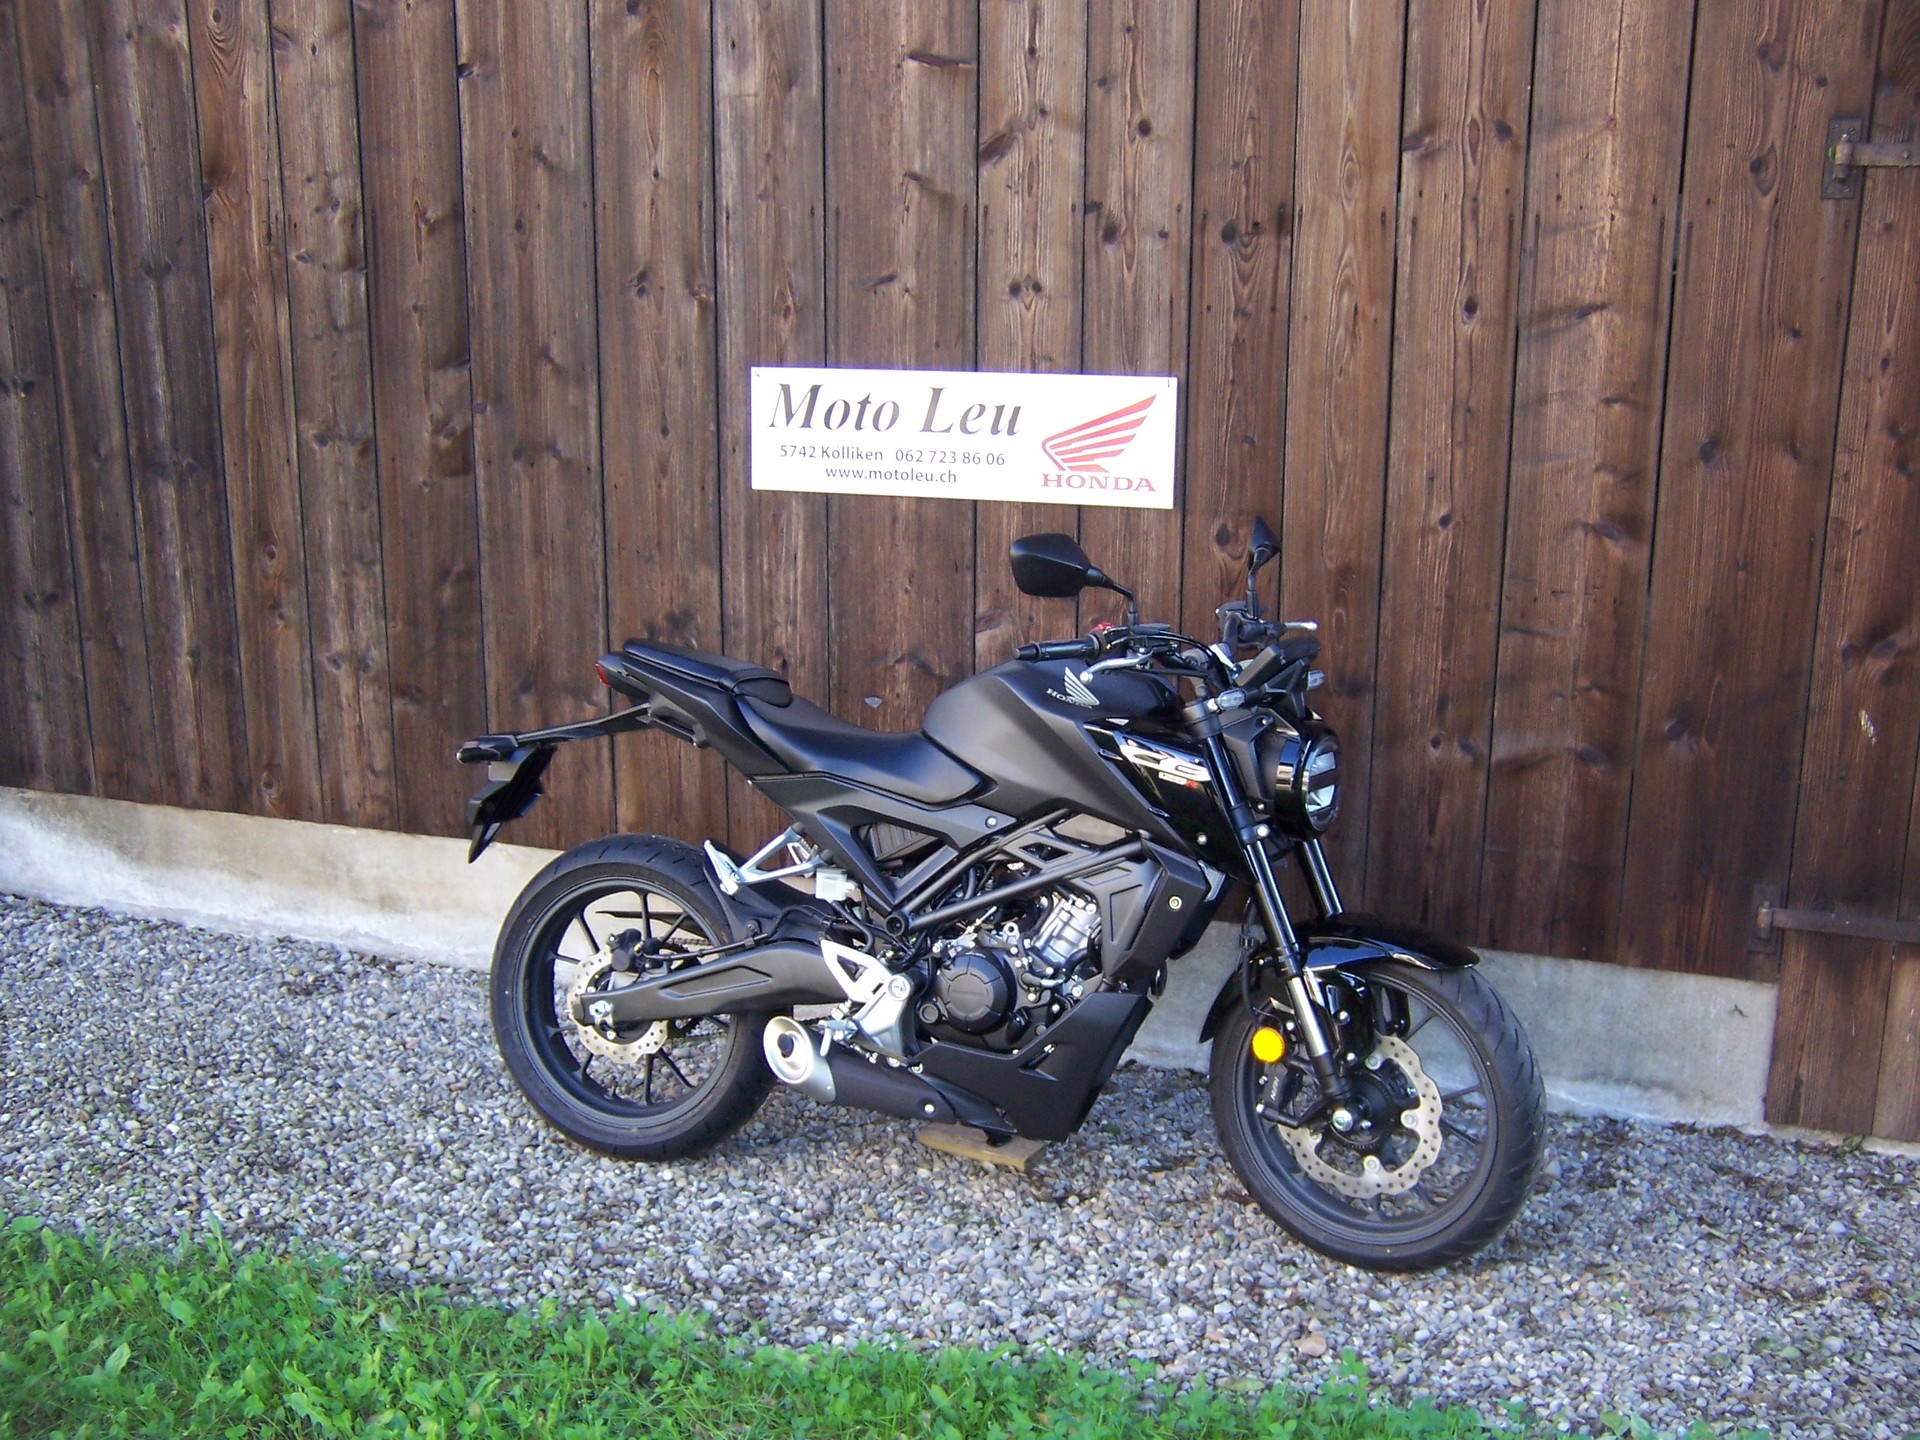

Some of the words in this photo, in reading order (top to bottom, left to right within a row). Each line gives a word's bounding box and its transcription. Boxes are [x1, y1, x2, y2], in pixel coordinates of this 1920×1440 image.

[767, 383, 900, 432] Moto
[918, 386, 1022, 436] Leu
[780, 445, 816, 458] 5742
[895, 449, 923, 462] 062
[929, 450, 957, 464] 723
[962, 452, 981, 465] 86
[986, 453, 1005, 466] 06
[825, 468, 957, 483] www.motoleu.ch
[1041, 474, 1157, 492] HONDA
